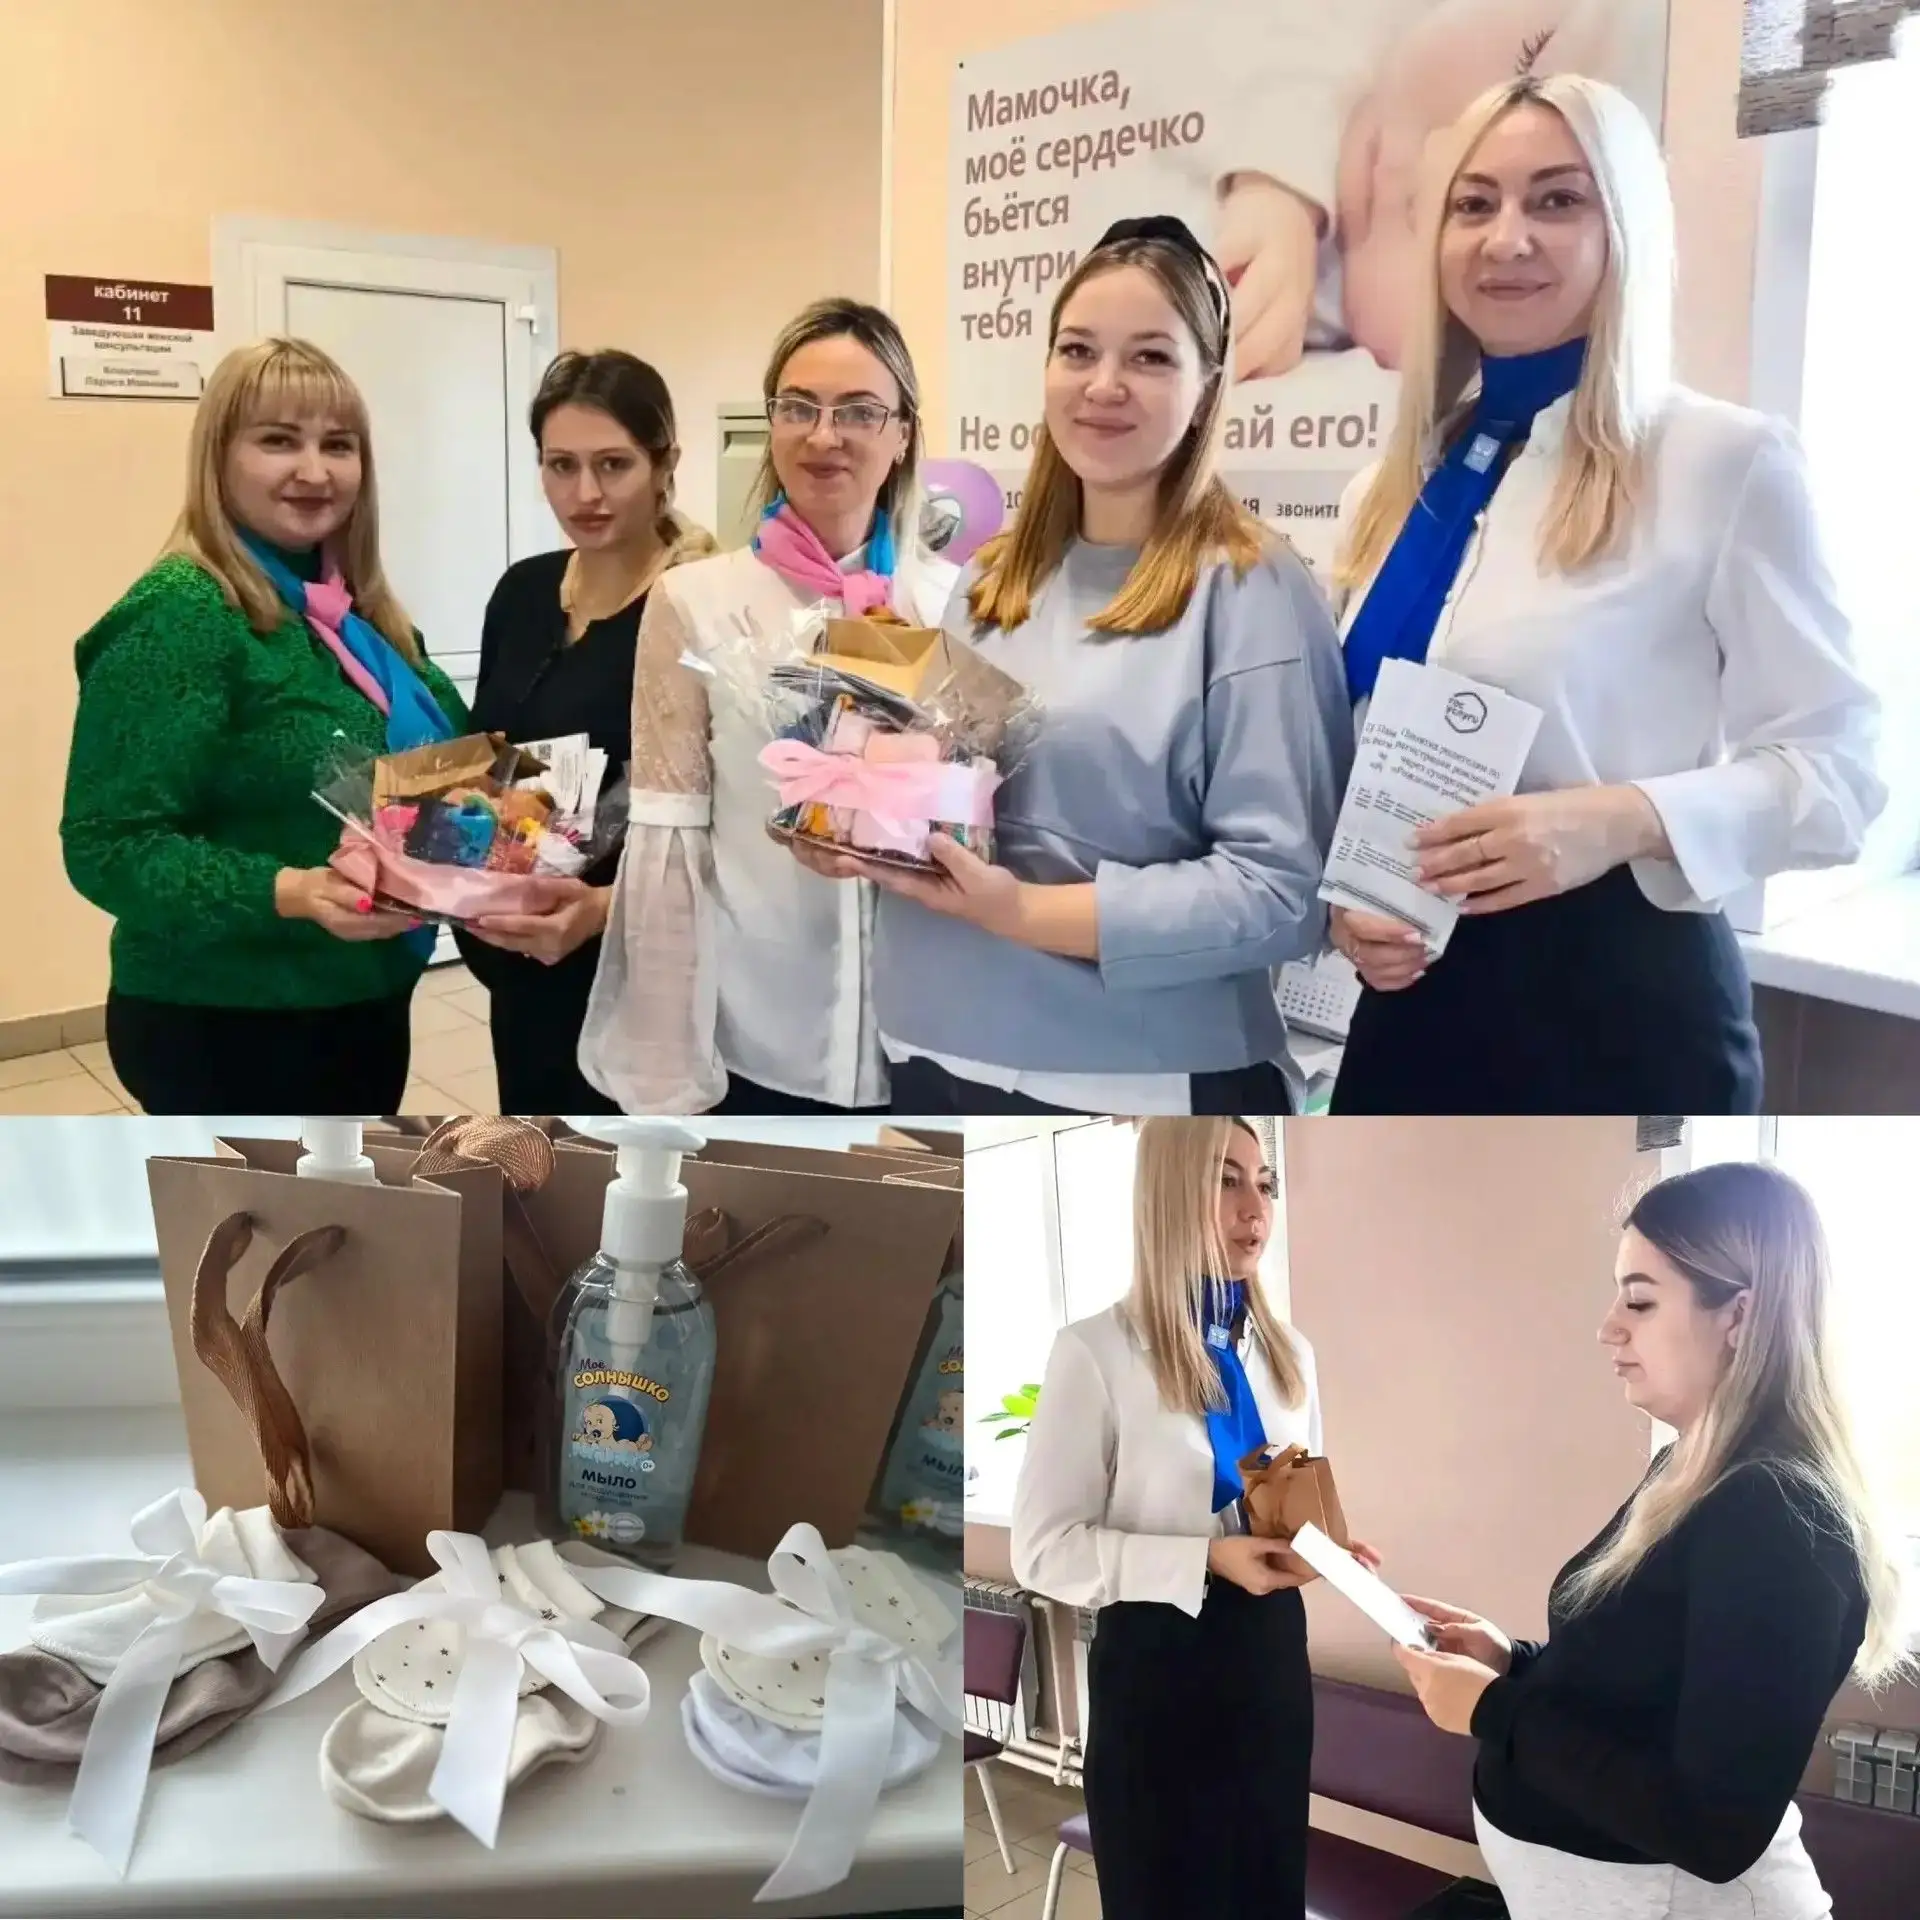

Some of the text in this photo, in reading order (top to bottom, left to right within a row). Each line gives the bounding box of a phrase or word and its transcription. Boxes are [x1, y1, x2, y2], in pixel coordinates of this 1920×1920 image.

[966, 68, 1131, 132] Мамочка,
[965, 110, 1205, 185] моё сердечко
[964, 191, 1069, 238] бьётся
[94, 284, 171, 303] кабинет
[963, 250, 1076, 296] внутри
[122, 306, 142, 321] 11
[960, 298, 1032, 341] тебя
[960, 416, 999, 452] Не
[1290, 403, 1379, 449] его!
